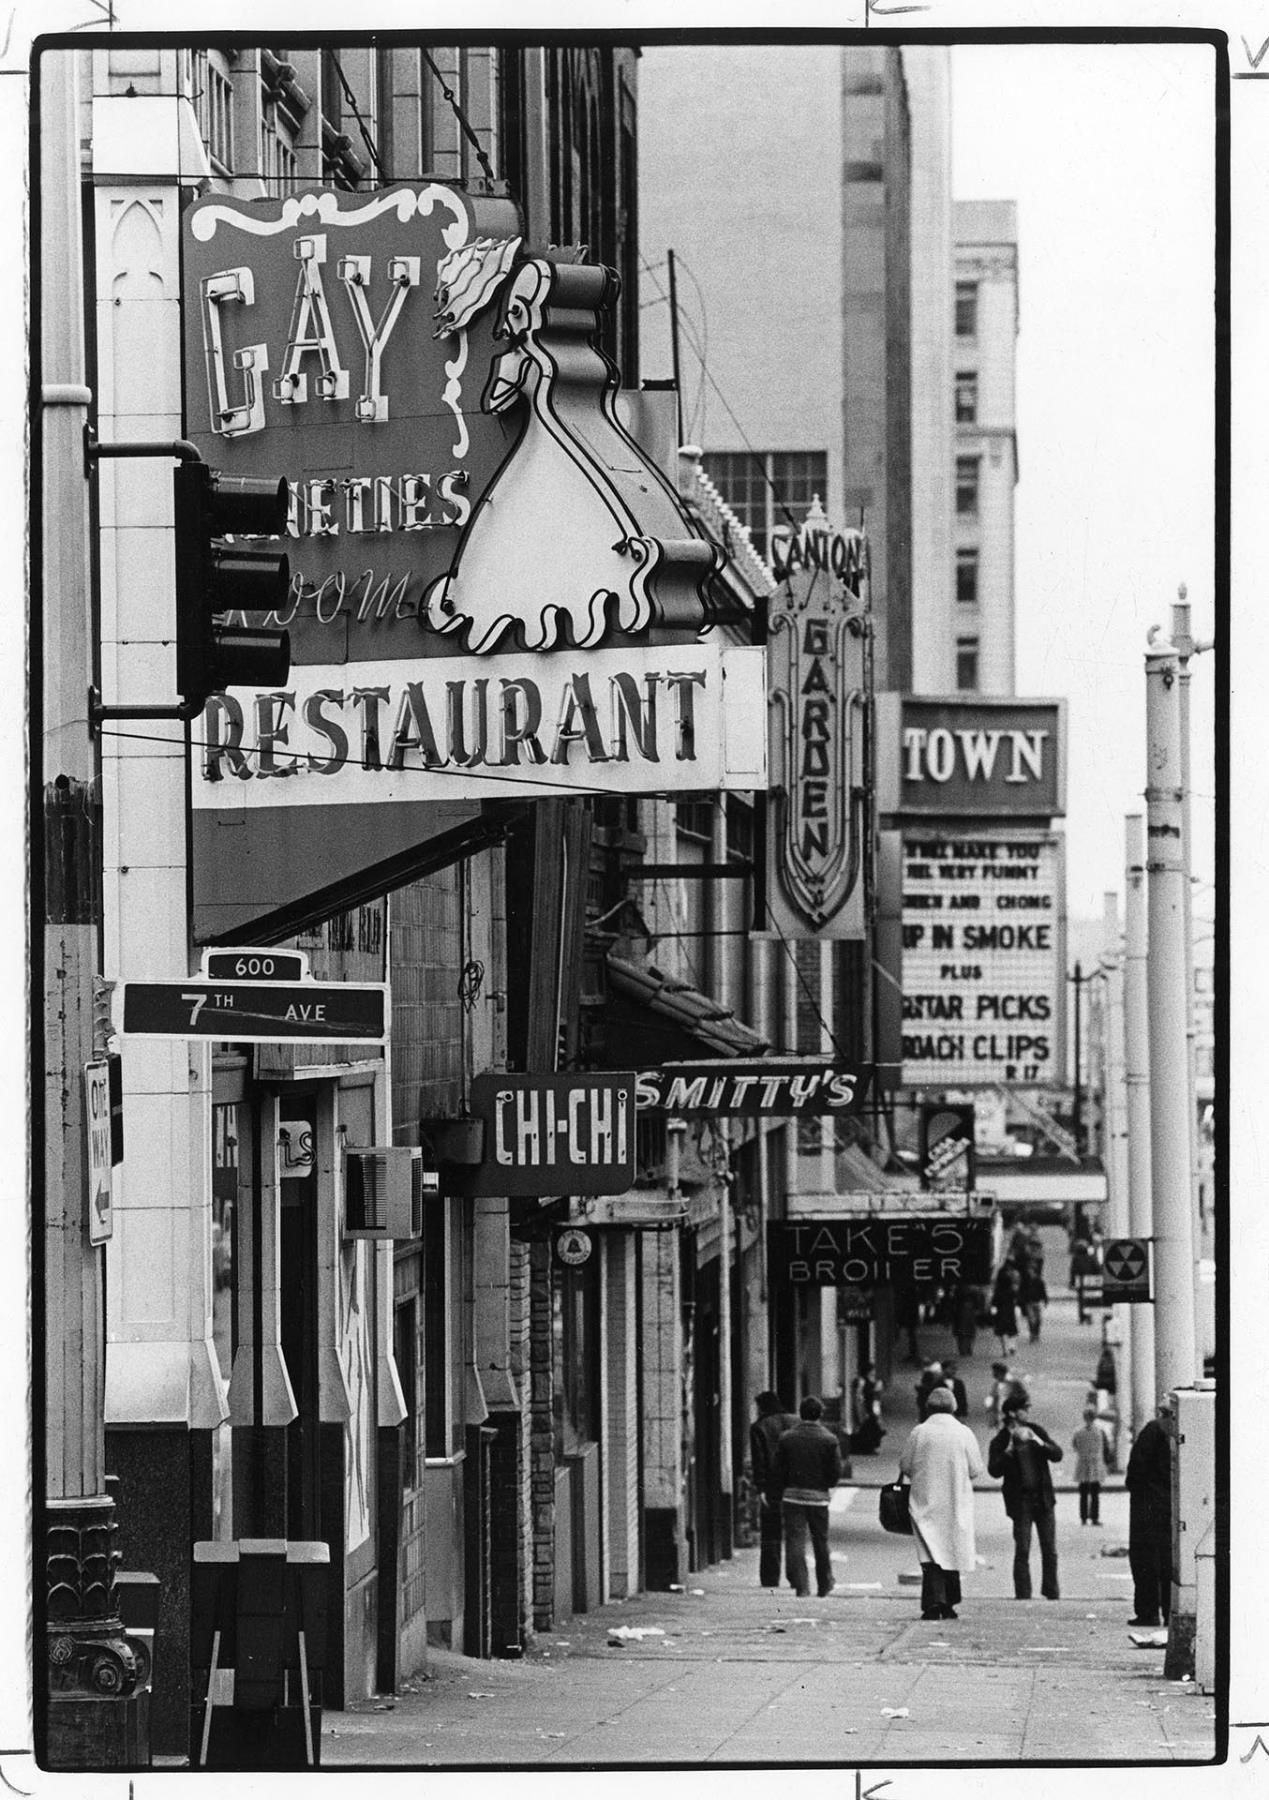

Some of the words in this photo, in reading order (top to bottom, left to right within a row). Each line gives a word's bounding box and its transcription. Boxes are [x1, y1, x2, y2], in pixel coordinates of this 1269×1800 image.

[201, 233, 421, 438] GAY
[771, 528, 863, 581] CANTON
[203, 669, 708, 782] RESTAURANT
[800, 618, 831, 861] GARDEN
[903, 727, 1050, 783] TOWN
[1007, 842, 1040, 859] YOU
[982, 865, 1039, 880] FUNNY
[949, 894, 981, 910] AND
[996, 895, 1051, 909] CHONG
[932, 924, 954, 950] IN
[963, 924, 1051, 951] SMOKE
[235, 958, 275, 976] 600
[940, 964, 983, 980] PLUS
[284, 1003, 327, 1022] AVE
[976, 994, 1051, 1020] PICKS
[973, 1034, 1050, 1061] CLIPS
[635, 1069, 858, 1110] SMITTY'S
[495, 1088, 628, 1165] CHI-CHI
[784, 1224, 909, 1255] TAKE
